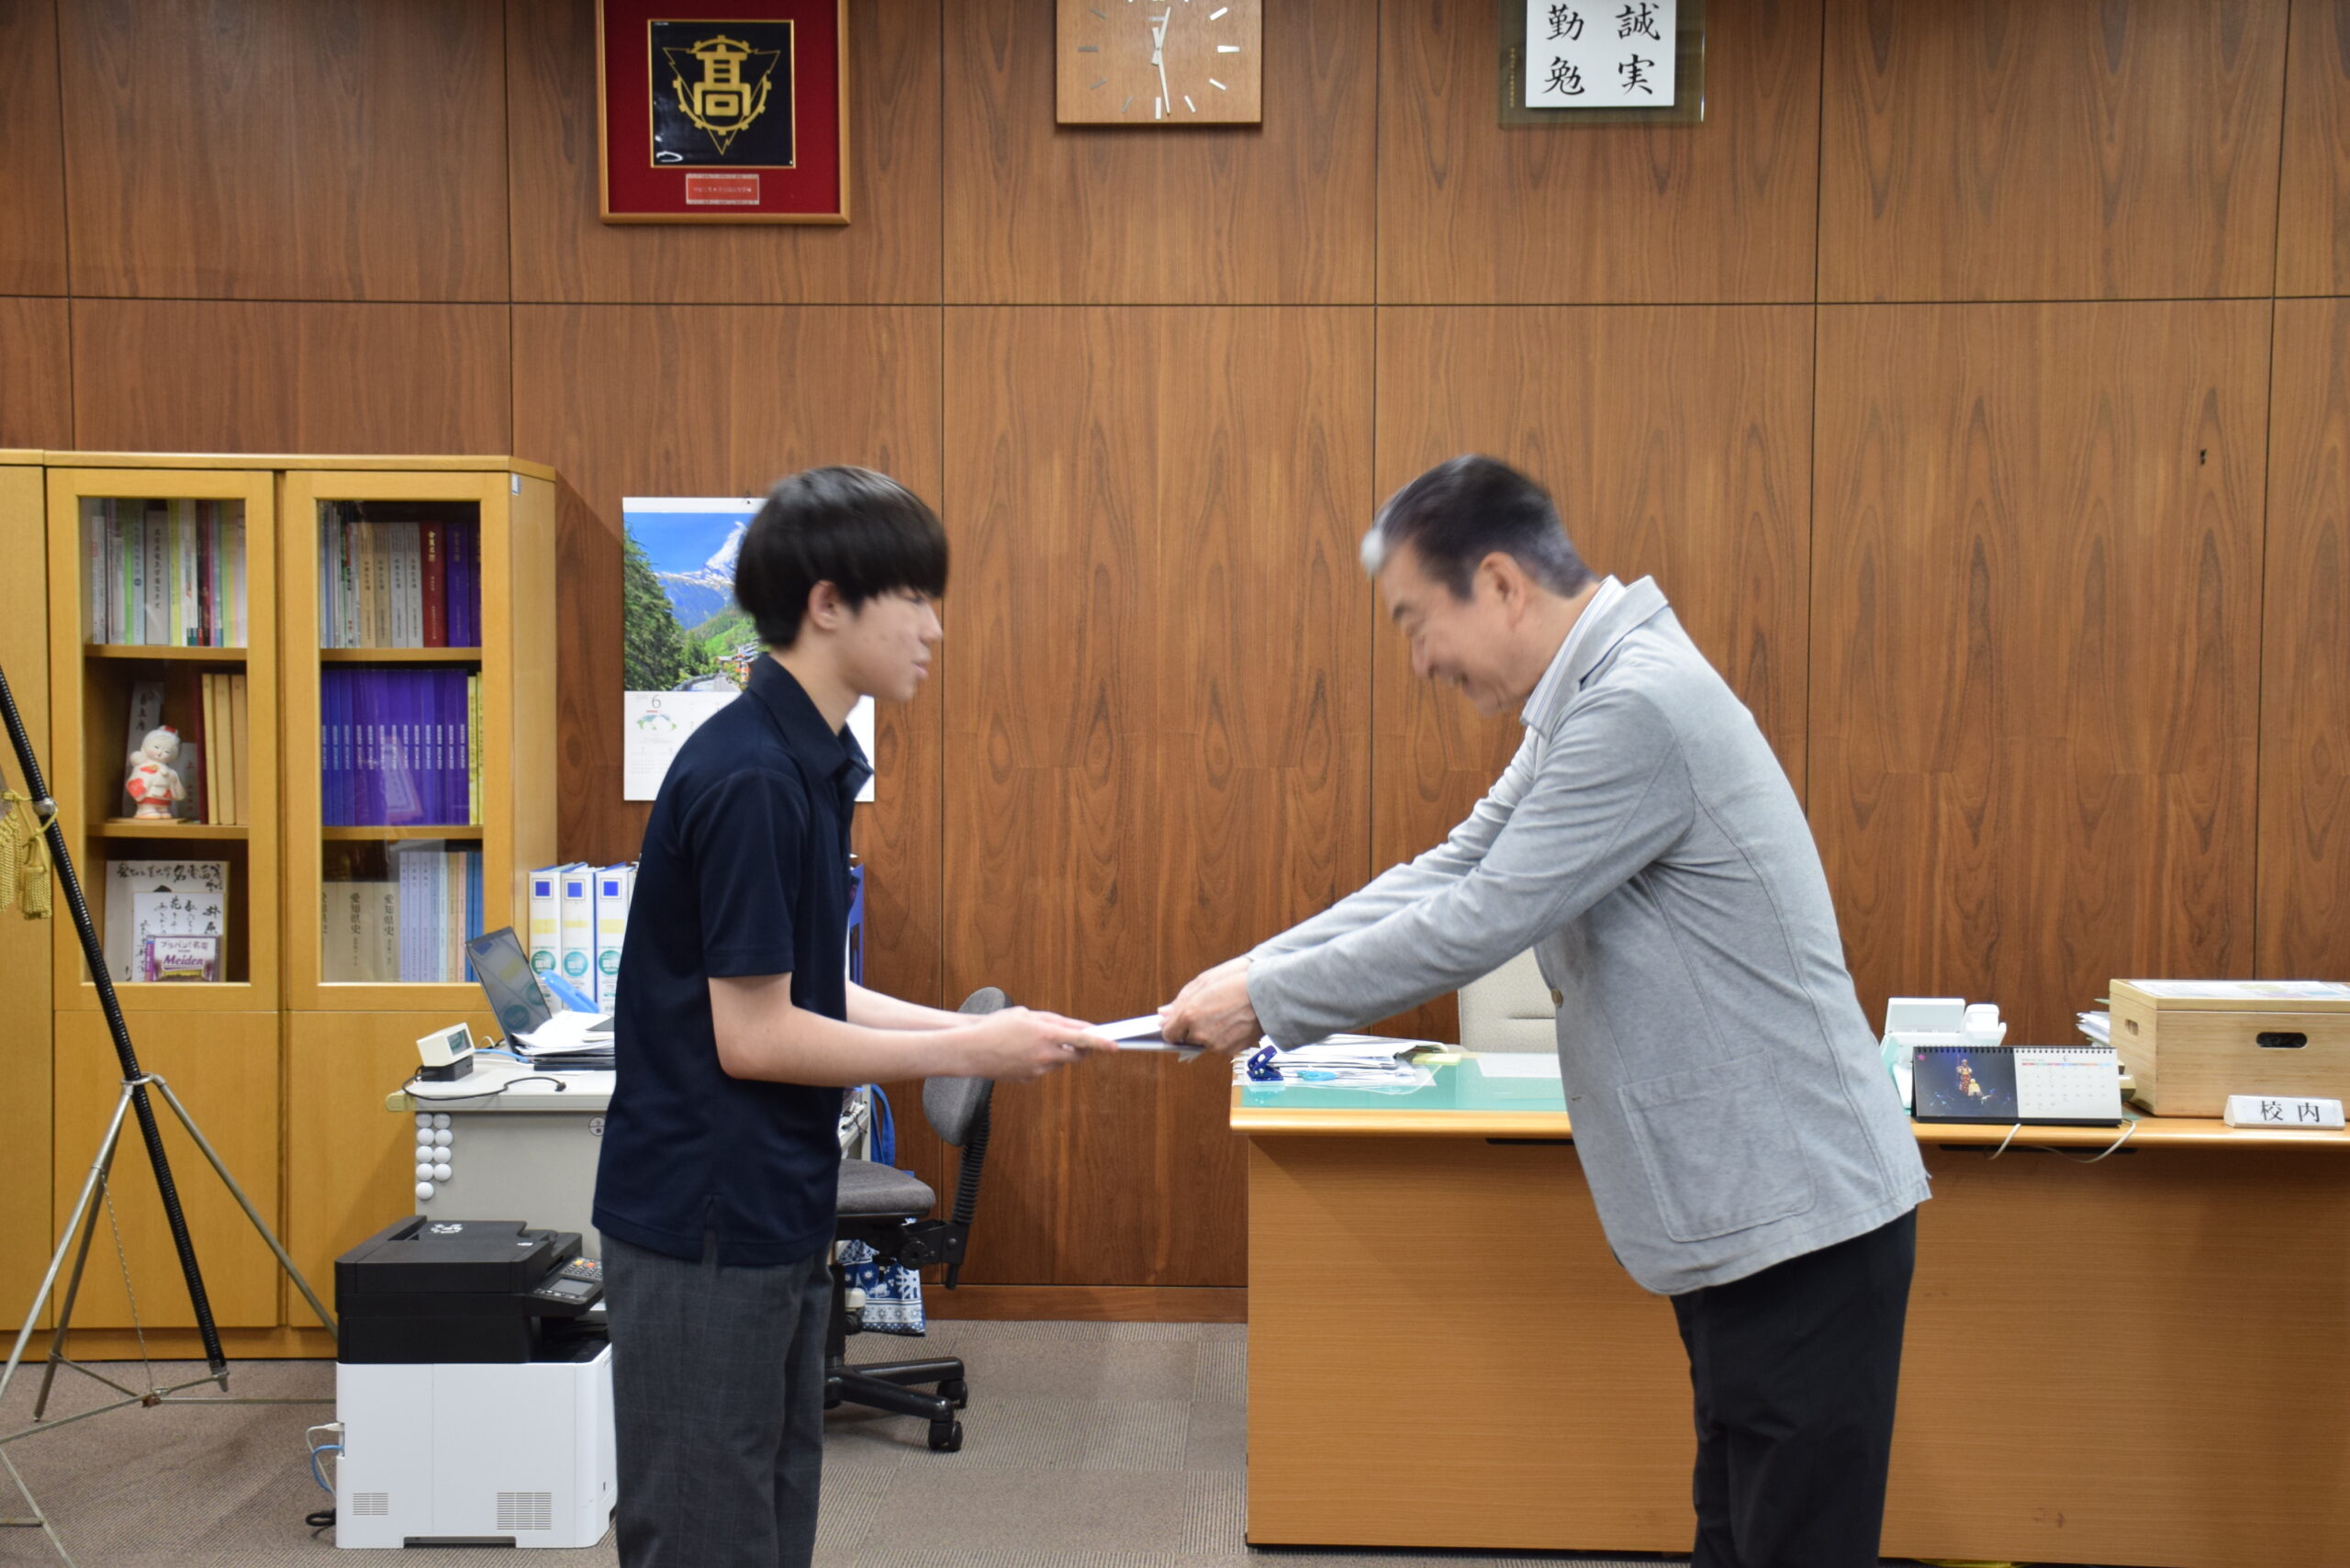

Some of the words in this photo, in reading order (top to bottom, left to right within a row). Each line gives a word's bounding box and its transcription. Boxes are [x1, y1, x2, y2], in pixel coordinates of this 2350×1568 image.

[1543, 4, 1584, 95] 勤勉
[1615, 2, 1661, 95] 誠実
[163, 954, 204, 966] Meiden
[2260, 1100, 2321, 1123] 校内
